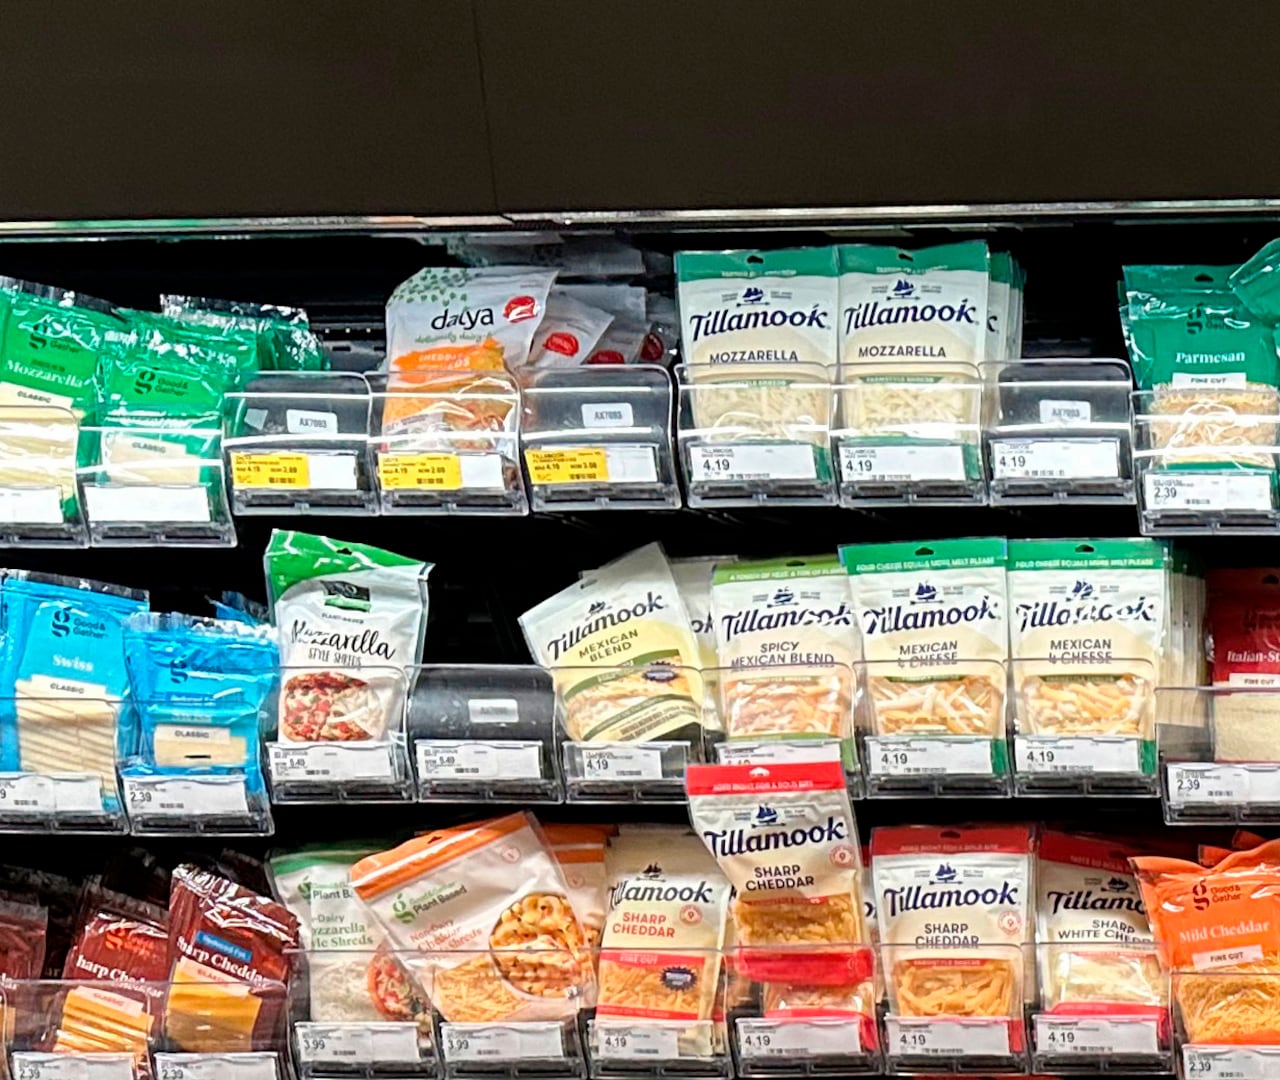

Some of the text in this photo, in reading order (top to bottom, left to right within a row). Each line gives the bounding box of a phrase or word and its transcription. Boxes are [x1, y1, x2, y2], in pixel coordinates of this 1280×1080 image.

[689, 303, 828, 342] Tillamook
[844, 297, 977, 336] Tillamook
[709, 349, 799, 364] MOZZARELLA
[858, 345, 947, 359] MOZZARELLA
[1175, 351, 1246, 365] Parmesan
[7, 359, 84, 389] Mozzarella
[702, 458, 731, 473] 4.19
[1153, 486, 1177, 500] 2.39
[864, 594, 998, 634] Tillamook
[547, 592, 664, 661] Tillamook
[578, 629, 639, 659] MEXICAN
[760, 641, 800, 654] SPICY
[900, 641, 958, 656] MEXICAN
[1050, 638, 1112, 650] MEXICAN
[52, 653, 95, 673] Swiss
[50, 682, 85, 694] CLASSIC
[882, 752, 907, 765] 4.19
[1027, 750, 1055, 763] 4.19
[129, 789, 152, 802] 2.39
[704, 816, 845, 857] Tillamook
[754, 865, 801, 879] SHARP
[745, 875, 815, 892] CHEDDAR
[412, 884, 467, 915] Plant Based
[884, 882, 1018, 917] Tillamook
[622, 910, 667, 926] SHARP
[612, 922, 676, 938] CHEDDAR
[925, 923, 969, 935] SHARP
[1179, 919, 1269, 942] Mild Cheddar
[447, 1037, 469, 1051] 3.99
[744, 1033, 771, 1048] 4.19
[1048, 1031, 1074, 1044] 4.19
